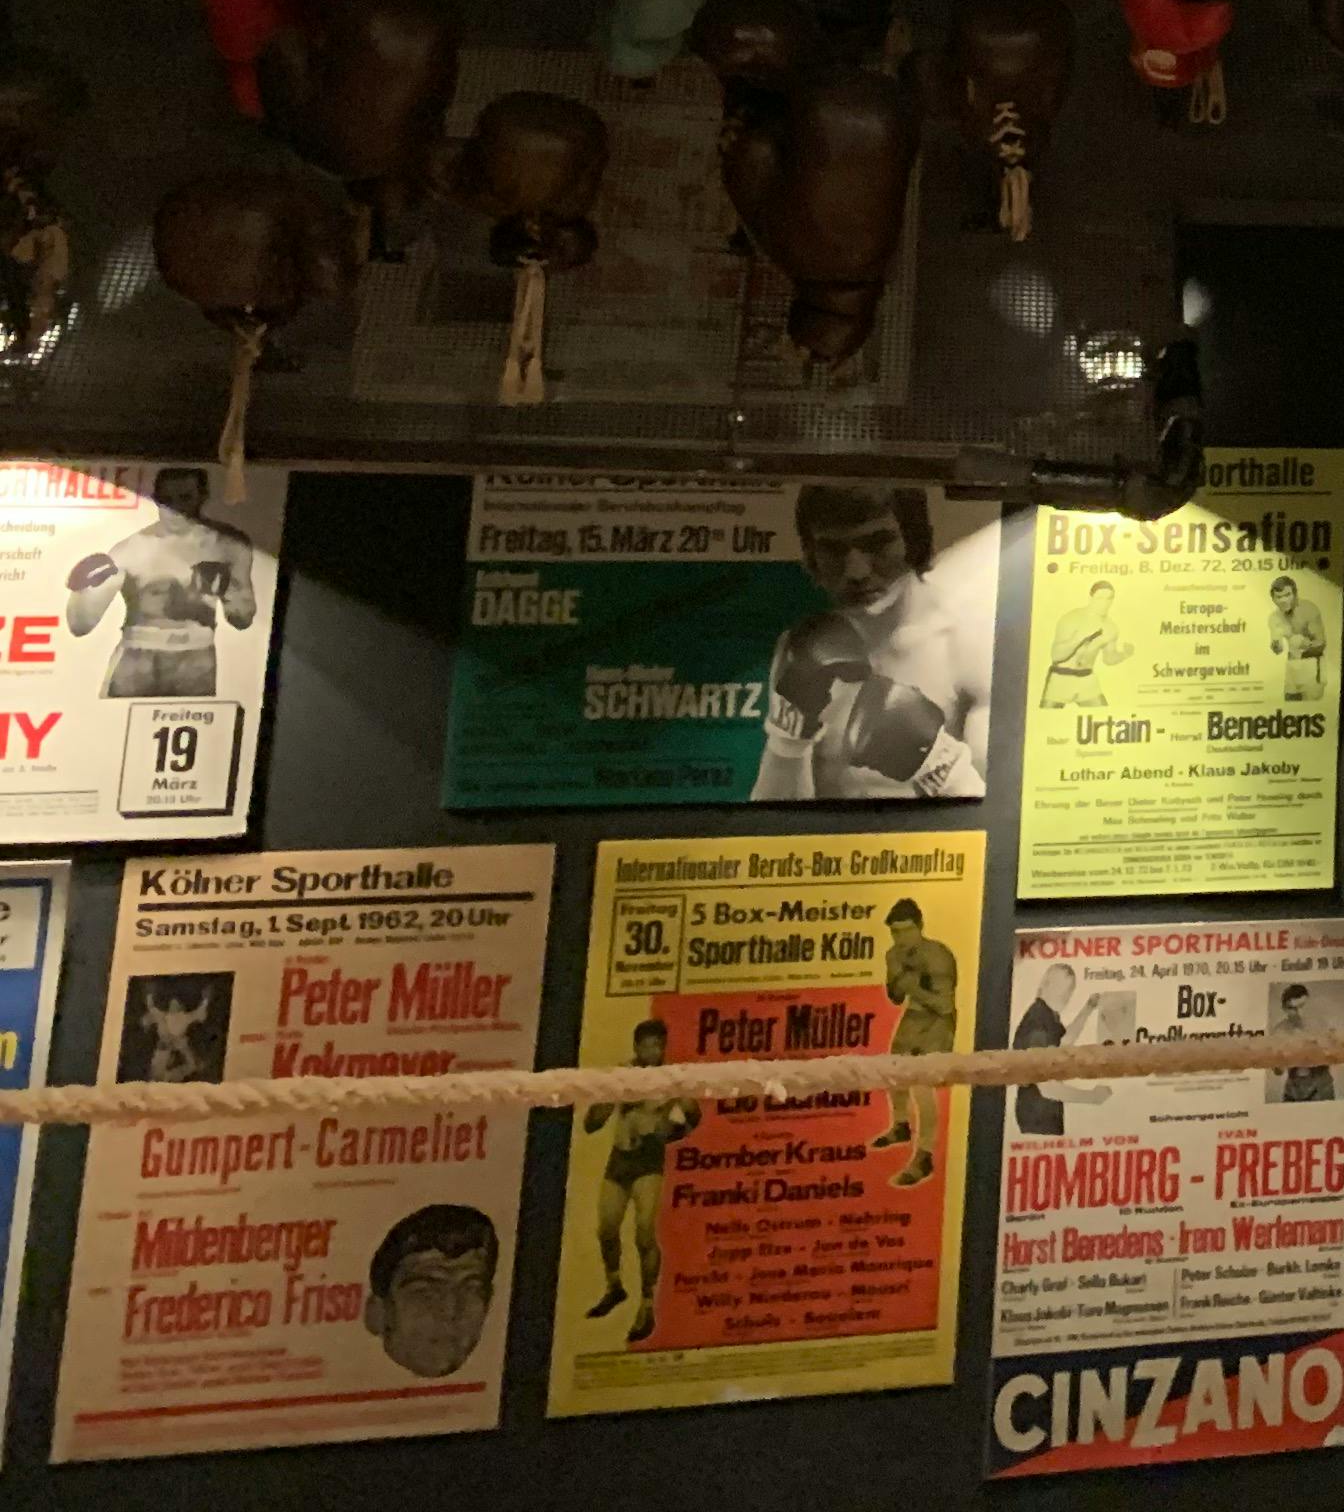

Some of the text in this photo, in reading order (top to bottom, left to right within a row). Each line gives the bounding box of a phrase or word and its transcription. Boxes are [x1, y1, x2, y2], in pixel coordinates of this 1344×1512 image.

[1202, 456, 1315, 487] orthalle
[609, 525, 674, 554] März
[731, 524, 777, 554] Uhr
[1048, 511, 1332, 555] Box-Sensation
[1069, 561, 1134, 576] Freitag,
[1160, 560, 1195, 574] Dez.
[1202, 559, 1227, 574] 72,
[1232, 558, 1274, 572] 20.15
[1278, 555, 1310, 571] Uhr
[472, 589, 582, 626] DAGGE
[0, 616, 59, 662] E
[1160, 619, 1247, 635] Meisterschaft
[1195, 642, 1210, 655] im
[1152, 662, 1250, 679] Schwergewicht
[152, 709, 214, 724] Freitag
[583, 682, 763, 720] SCHWARTZ
[1077, 712, 1151, 745] Urtain
[1207, 709, 1326, 742] Benedens
[153, 726, 198, 773] 19
[152, 777, 198, 790] März
[1060, 761, 1300, 782] Lothar Abend Klaus Jakoby
[139, 861, 454, 898] Kölner Sporthalle
[615, 857, 741, 883] Internationaler
[135, 917, 262, 938] Samstag,
[430, 908, 464, 928] 20
[467, 906, 512, 928] Uhr
[691, 899, 878, 925] 5 Box-Meister
[624, 920, 670, 956] 30.
[688, 931, 874, 969] Sporthalle Köln
[1133, 929, 1290, 957] SPORTHALLE
[1084, 967, 1126, 981] Freitag,
[1152, 963, 1179, 979] April
[1249, 961, 1267, 974] Uhr
[277, 960, 513, 1027] Peter Müller
[1177, 984, 1226, 1019] Box-
[697, 1001, 875, 1055] Peter Müller
[1149, 1110, 1249, 1124] Schwergewicht
[141, 1112, 488, 1184] Gumpert Carmeliet
[675, 1140, 867, 1171] Bomber Kraus
[1010, 1128, 1258, 1151] WILHELM VON IVAN
[764, 1175, 865, 1202] Daniels
[1006, 1146, 1181, 1213] HOMBURG
[132, 1213, 338, 1272] Mildenberger
[1003, 1231, 1057, 1268] Horst
[1062, 1224, 1164, 1264] Benedens
[124, 1274, 364, 1340] Frederico Friso
[993, 1348, 1344, 1454] CINZANO
